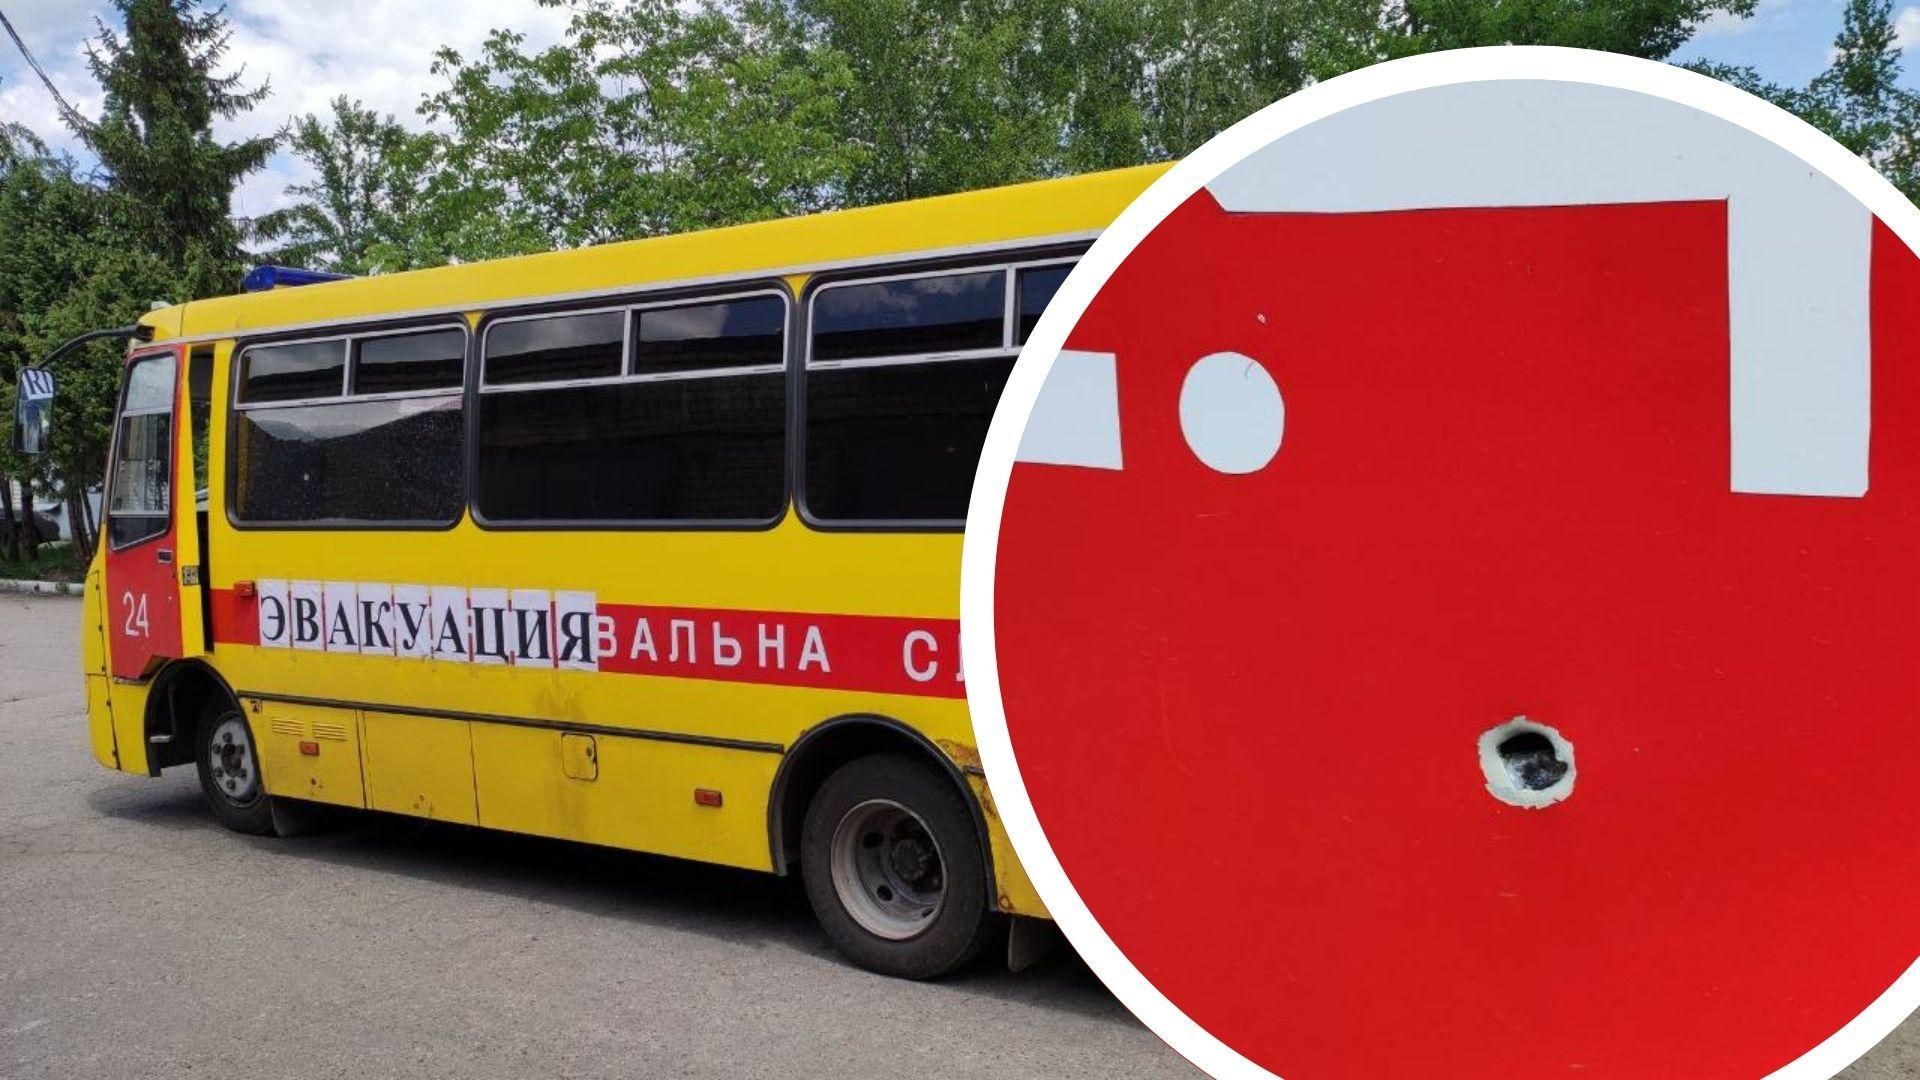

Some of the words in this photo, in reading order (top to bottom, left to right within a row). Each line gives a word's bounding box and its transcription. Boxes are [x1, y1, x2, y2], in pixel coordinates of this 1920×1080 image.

[123, 590, 150, 638] 24
[261, 595, 596, 665] ЭВАКУАЦИЯ
[903, 629, 965, 683] С
